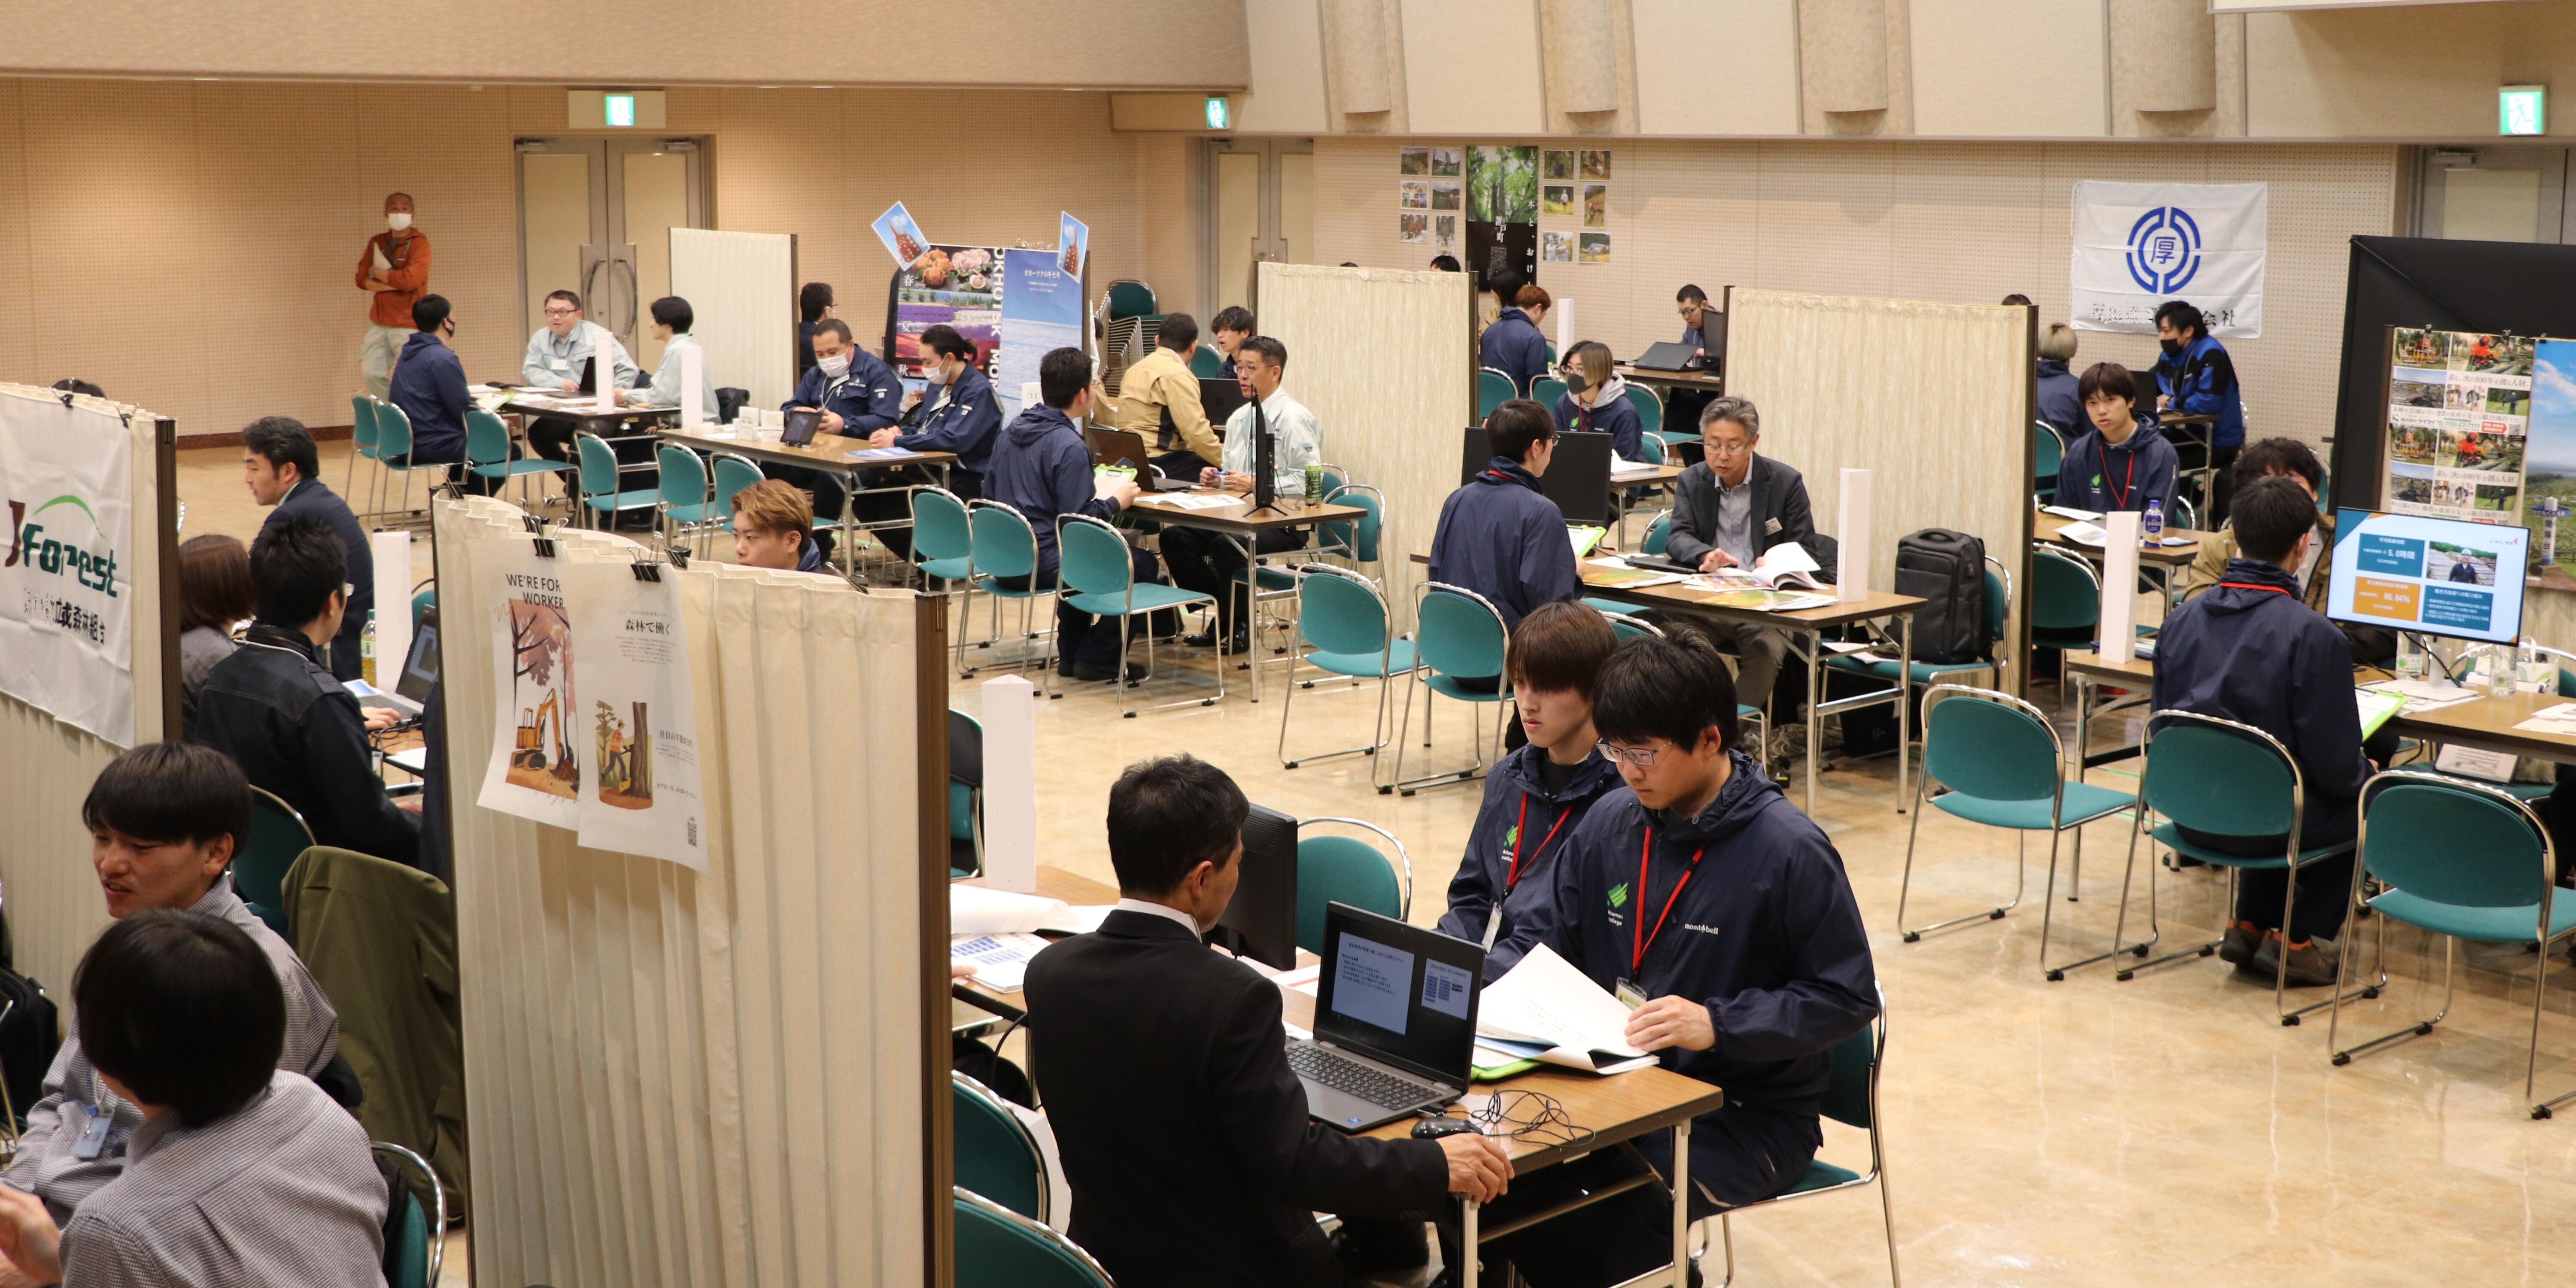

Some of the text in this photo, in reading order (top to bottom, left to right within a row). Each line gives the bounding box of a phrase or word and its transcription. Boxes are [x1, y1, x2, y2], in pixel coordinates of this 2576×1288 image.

[2151, 236, 2176, 264] 厚
[903, 274, 914, 287] 春
[1024, 269, 1061, 279] オホーツクのキセキ
[990, 248, 1005, 337] OKHOTSK
[901, 321, 911, 333] 夏
[898, 364, 909, 377] 秋
[506, 574, 538, 589] WE'RE
[626, 619, 670, 635] 森林で働く
